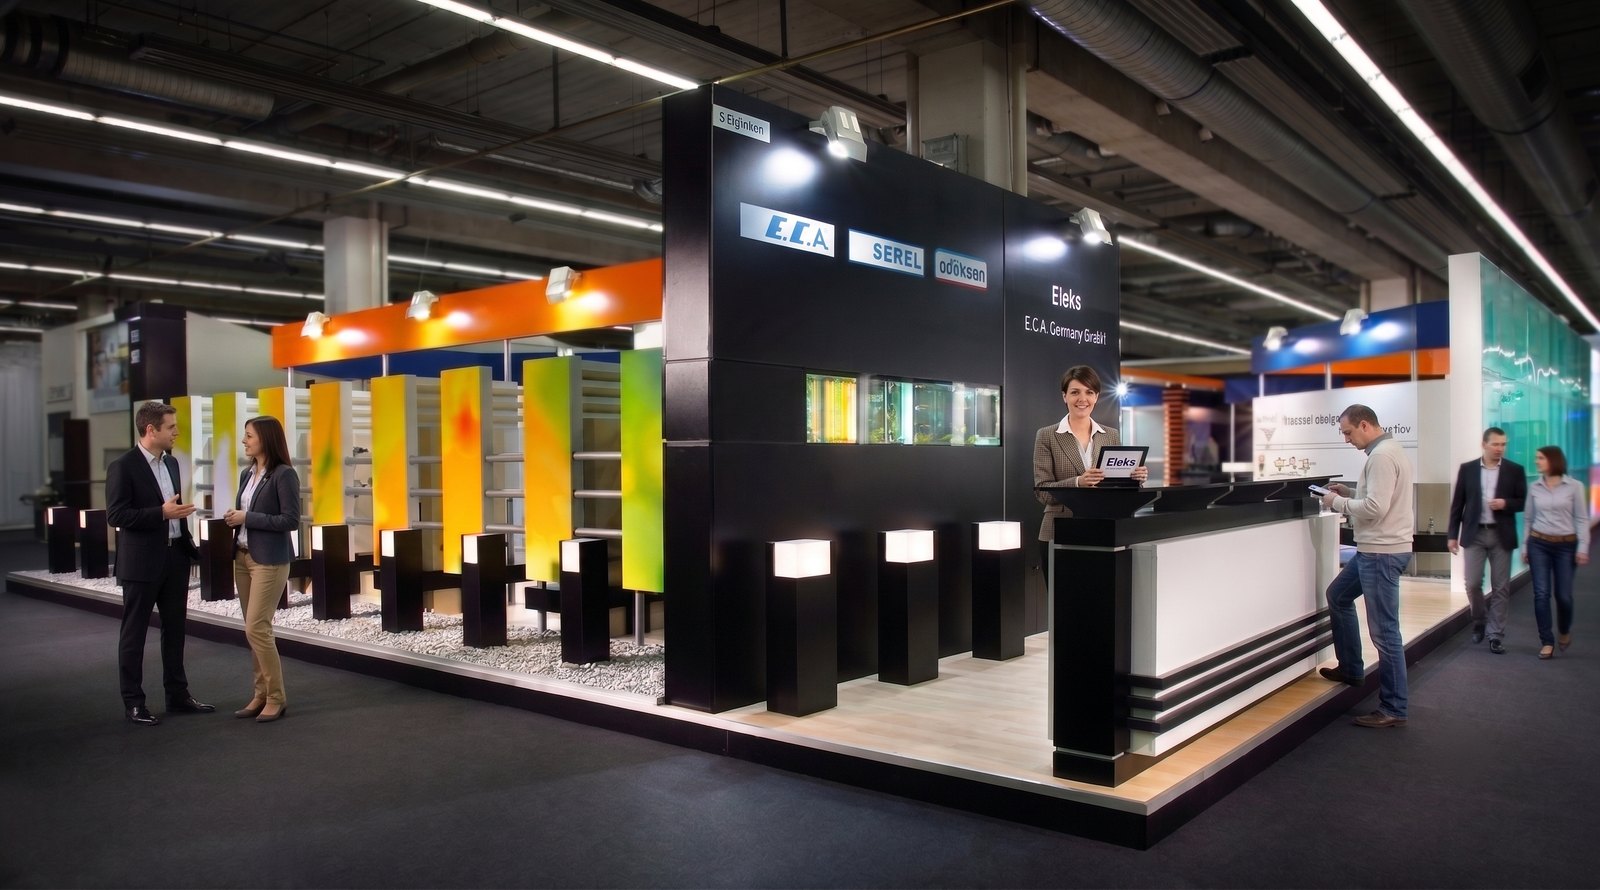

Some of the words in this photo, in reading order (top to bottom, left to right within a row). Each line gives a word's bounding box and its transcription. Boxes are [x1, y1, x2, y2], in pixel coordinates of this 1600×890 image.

[719, 111, 725, 123] S
[872, 242, 922, 270] SEREL
[1051, 285, 1082, 311] Eleks
[1106, 457, 1136, 467] Eleks
